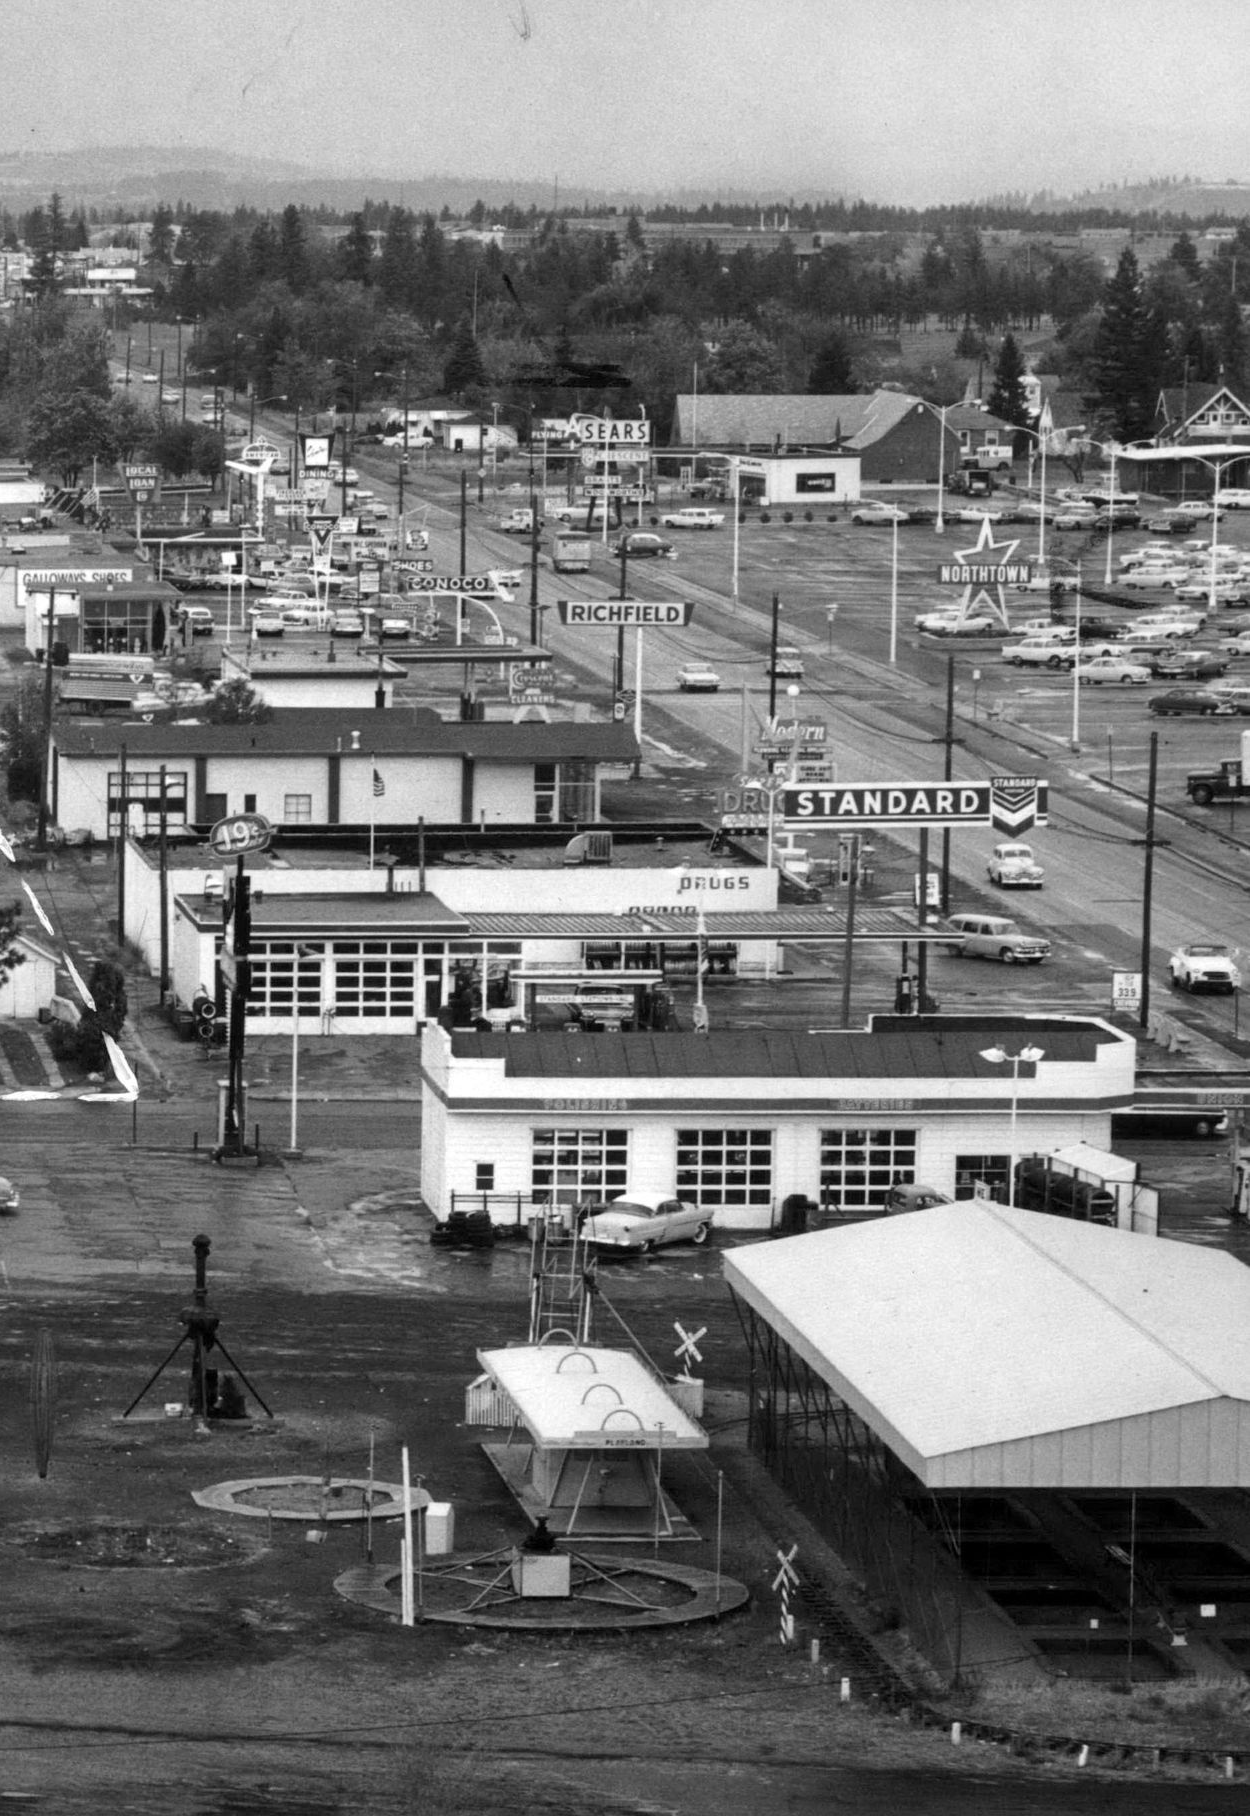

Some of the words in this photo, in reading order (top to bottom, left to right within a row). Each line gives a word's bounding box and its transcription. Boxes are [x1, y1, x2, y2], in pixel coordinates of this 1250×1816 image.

[531, 430, 563, 439] FLYING
[585, 423, 646, 440] SEARS
[126, 466, 157, 477] LOCAL
[299, 470, 334, 479] DINING
[130, 478, 155, 489] LOAN
[393, 560, 433, 572] SHOES
[941, 565, 1029, 583] NORTHTOWN
[411, 577, 485, 590] CONOCO
[571, 604, 680, 623] RICHFIELD
[993, 778, 1036, 788] STANDARD
[797, 789, 980, 817] STANDARD
[680, 876, 750, 891] DRUGS
